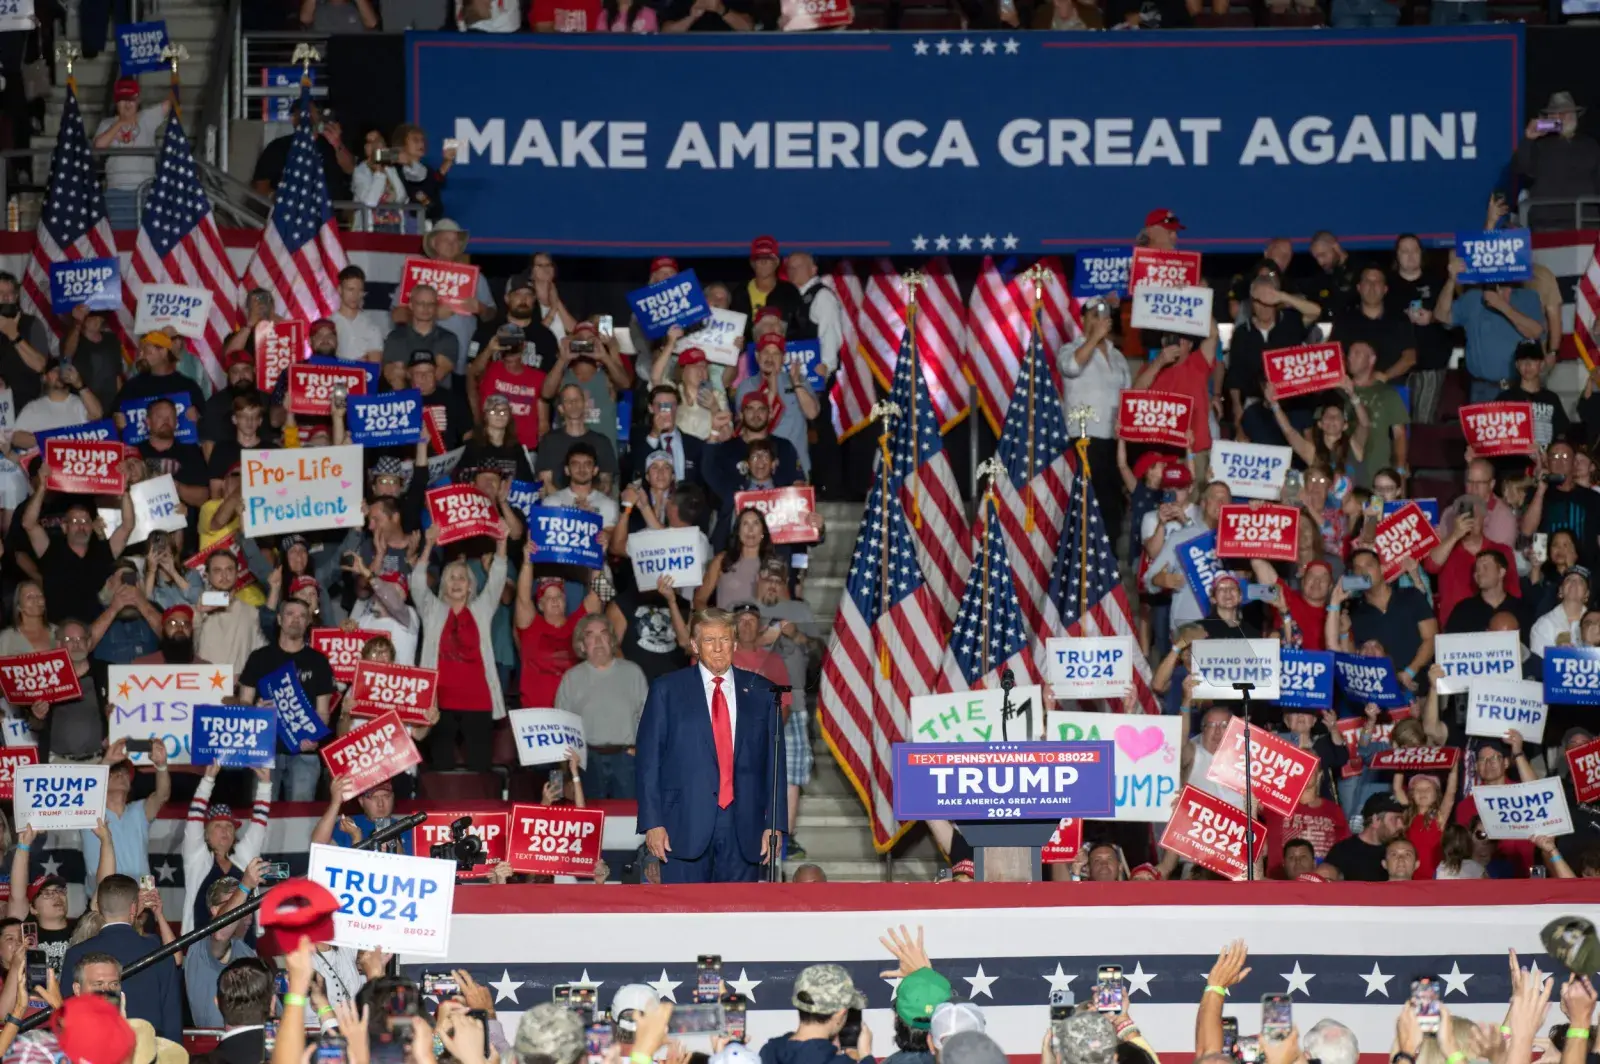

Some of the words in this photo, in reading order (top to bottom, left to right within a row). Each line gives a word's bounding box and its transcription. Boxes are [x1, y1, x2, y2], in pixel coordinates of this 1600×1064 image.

[122, 30, 164, 46] TRUMP
[131, 44, 162, 58] 2024
[454, 117, 647, 169] MAKE
[666, 120, 980, 168] AMERICA
[998, 118, 1221, 166] GREAT
[1239, 112, 1477, 164] AGAIN!
[1464, 238, 1524, 254] TRUMP
[1084, 257, 1132, 271] TRUM
[1472, 252, 1516, 267] 2024
[56, 268, 112, 284] TRUMP
[411, 268, 470, 286] TRUMP
[1090, 270, 1130, 284] 2024
[64, 282, 104, 296] 2024
[636, 282, 692, 312] TRUMP
[146, 293, 203, 308] TRUMP
[1143, 292, 1204, 306] TRUMP
[152, 305, 191, 318] 2024
[649, 298, 692, 322] 2024
[1152, 304, 1195, 318] 2024
[702, 318, 737, 334] UMP
[266, 322, 276, 389] TRUMP
[1271, 349, 1335, 370] TRUMP
[1282, 362, 1328, 379] 2024
[296, 372, 360, 388] TRUMP
[127, 403, 185, 424] TRP
[355, 400, 416, 419] TRUMP
[1126, 399, 1188, 415] TRUMP
[365, 414, 410, 432] 2024
[1134, 414, 1178, 428] 2024
[1466, 412, 1526, 428] TRUMP
[1476, 426, 1520, 441] 2024
[54, 448, 119, 464] TRUMP
[1220, 452, 1282, 470] TRUMP
[62, 461, 109, 476] 2024
[247, 457, 343, 487] Pro-Life
[1228, 468, 1270, 482] 2024
[436, 494, 492, 512] TRUMP
[509, 491, 542, 504] UMP
[250, 496, 348, 528] President
[447, 506, 490, 524] 2024
[539, 516, 599, 534] TRUMP
[1227, 515, 1292, 530] TRUMP
[1376, 514, 1420, 547] RUMP
[546, 532, 590, 548] 2024
[1234, 527, 1282, 541] 2024
[640, 548, 666, 558] STAND
[669, 546, 693, 554] WITH
[1382, 531, 1420, 562] 2024
[638, 556, 695, 574] TRUMP
[320, 638, 364, 650] TRUM
[329, 652, 362, 664] 202
[1056, 649, 1122, 664] TRUMP
[1450, 651, 1484, 660] STAND
[1486, 650, 1512, 658] WITH
[1, 659, 64, 679] TRUMP
[1066, 664, 1114, 678] 2024
[1200, 668, 1272, 681] TRUMP
[1338, 661, 1388, 678] TRUMP
[1444, 660, 1514, 676] TRUMP
[16, 674, 60, 691] 2024
[130, 673, 200, 692] WE
[364, 671, 430, 692] TRUMP
[1281, 675, 1316, 690] 024
[1348, 678, 1384, 692] 2024
[1562, 673, 1600, 688] 202
[280, 672, 317, 735] TRUMP
[369, 686, 418, 706] 2024
[1484, 694, 1514, 704] STAND
[1520, 699, 1542, 708] WITH
[116, 702, 189, 724] MIS
[273, 688, 302, 734] 2024
[1477, 704, 1542, 724] TRUMP
[200, 716, 269, 734] TRUMP
[919, 700, 986, 740] THE
[529, 724, 560, 733] STAND
[563, 727, 582, 736] WITH
[208, 732, 258, 748] 2024
[333, 724, 396, 766] TRUMP
[524, 735, 584, 750] TRUMP
[349, 744, 396, 775] 2024
[914, 754, 944, 764] TEXT
[946, 753, 1036, 764] PENNSYLVANIA
[1039, 753, 1055, 762] TO
[1058, 752, 1094, 762] 88022
[1236, 734, 1304, 777] TRUMP
[1381, 754, 1448, 762] TRUMP
[22, 778, 98, 792] TRUMP
[930, 766, 1078, 794] TRUMP
[32, 794, 84, 808] 2024
[1485, 790, 1554, 810] TRUMP
[988, 808, 1021, 818] 2024
[1498, 807, 1548, 822] 2024
[422, 824, 500, 842] TRMP
[521, 818, 594, 838] TRUMP
[528, 836, 582, 854] 2024
[1189, 822, 1242, 857] 2024
[535, 854, 560, 862] TRUMP
[1192, 840, 1214, 854] TRUMP
[1216, 853, 1226, 861] TO
[325, 866, 438, 899] TRUMP
[338, 894, 418, 922] 2024
[348, 920, 383, 932] TRUMP
[404, 927, 436, 936] 88022
